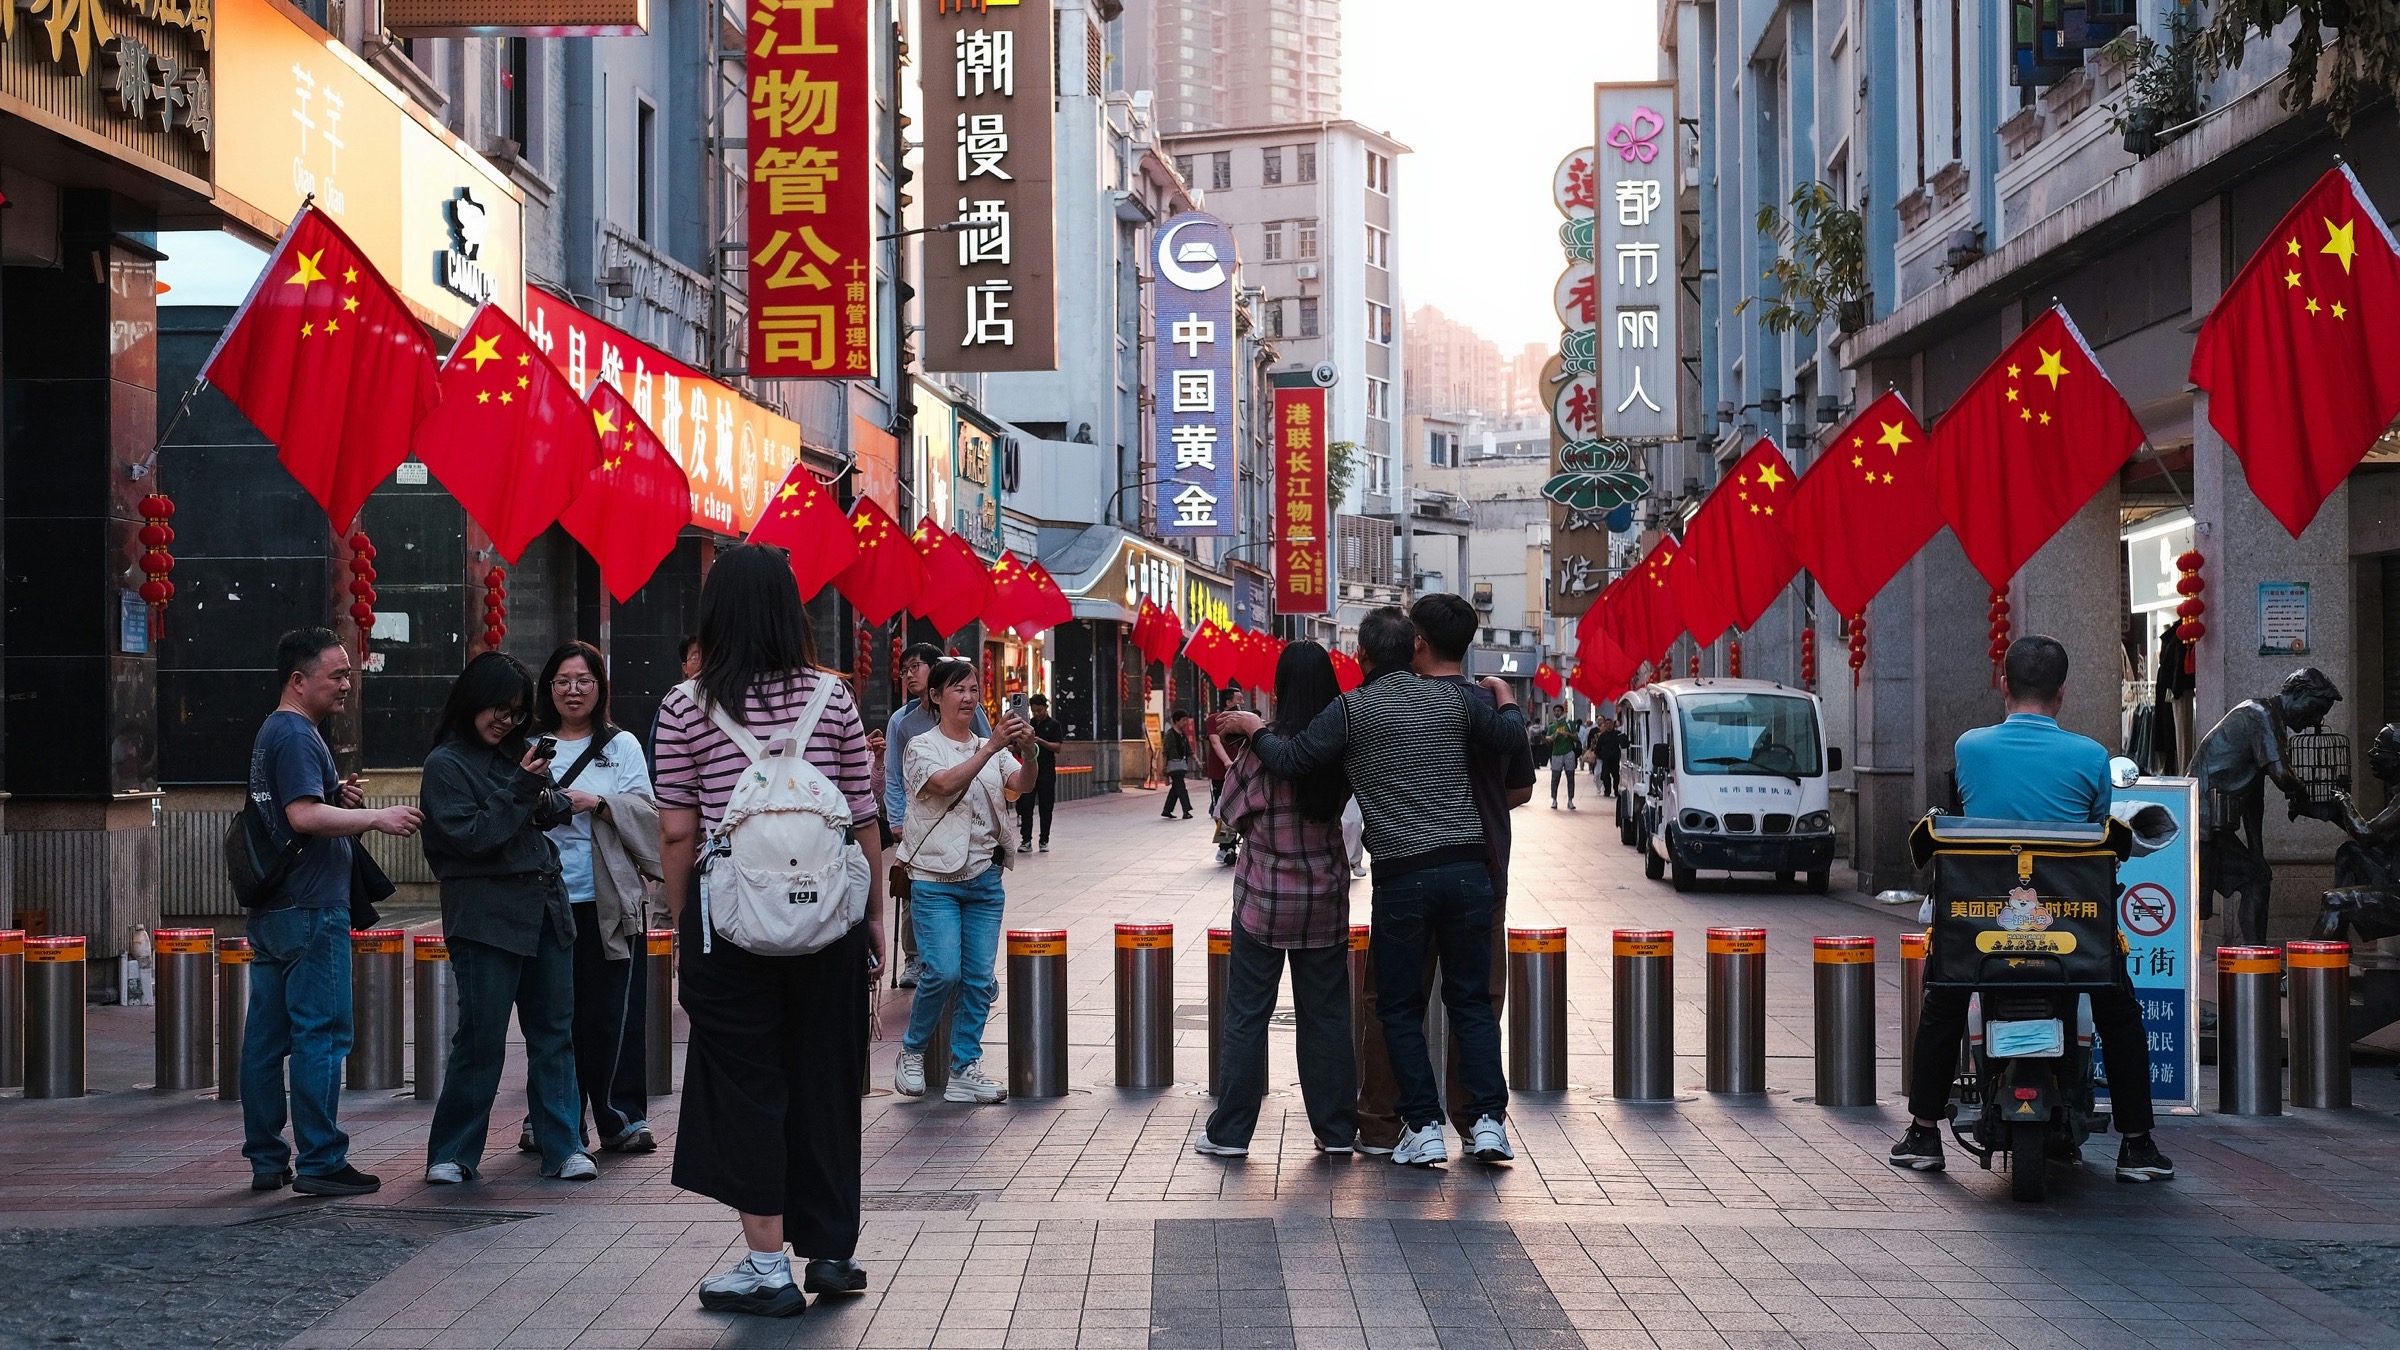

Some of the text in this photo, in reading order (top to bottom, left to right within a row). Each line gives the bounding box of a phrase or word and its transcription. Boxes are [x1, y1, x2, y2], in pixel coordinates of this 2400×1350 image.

[115, 35, 212, 153] 椰子鸡
[293, 157, 344, 215] Qian Qian
[955, 28, 1014, 347] 潮漫酒店
[845, 258, 867, 370] 十甫管理处
[1615, 179, 1661, 413] 都市丽人
[1171, 312, 1218, 527] 中国黄金
[704, 491, 732, 530] cheap
[1286, 403, 1313, 595] 港联长江物管公司
[1719, 786, 1792, 796] 城市管理执法
[2002, 914, 2047, 926] 一路平安
